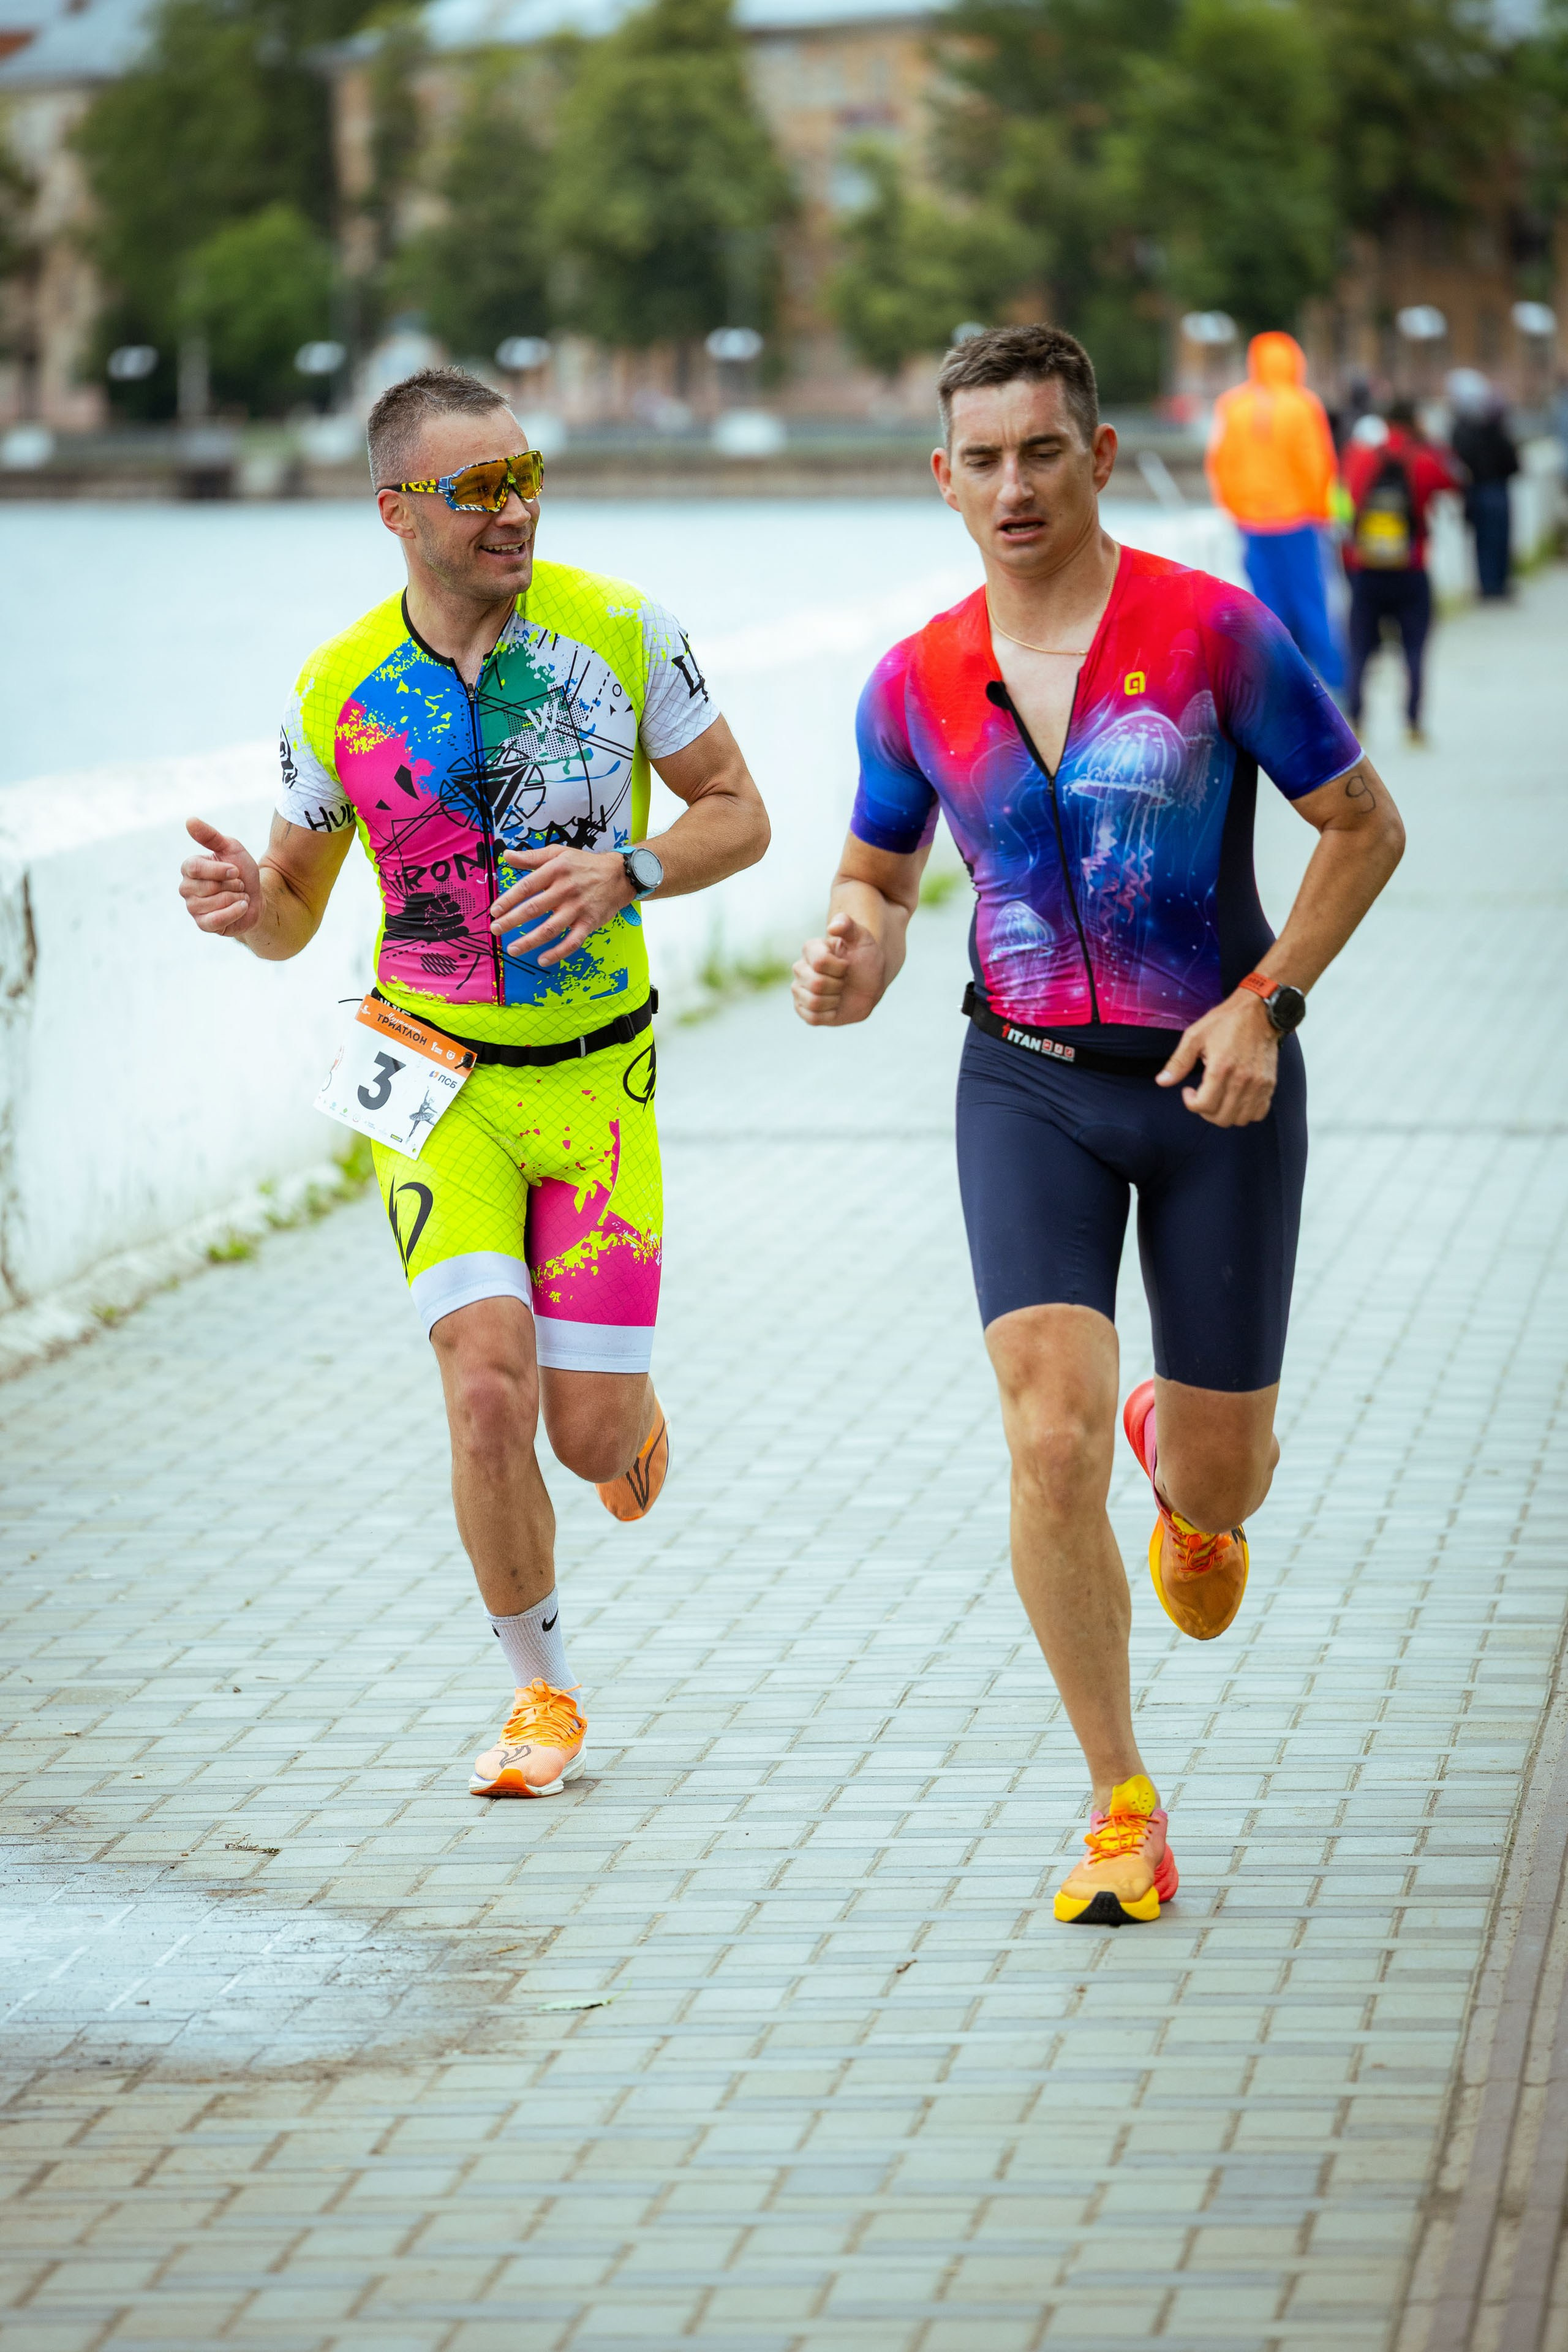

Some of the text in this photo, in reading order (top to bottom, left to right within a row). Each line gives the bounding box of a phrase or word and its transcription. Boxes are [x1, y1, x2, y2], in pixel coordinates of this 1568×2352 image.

[377, 1013, 428, 1046] ТРИАТЛОН
[357, 1051, 406, 1110] 3
[437, 1074, 458, 1088] ПСБ
